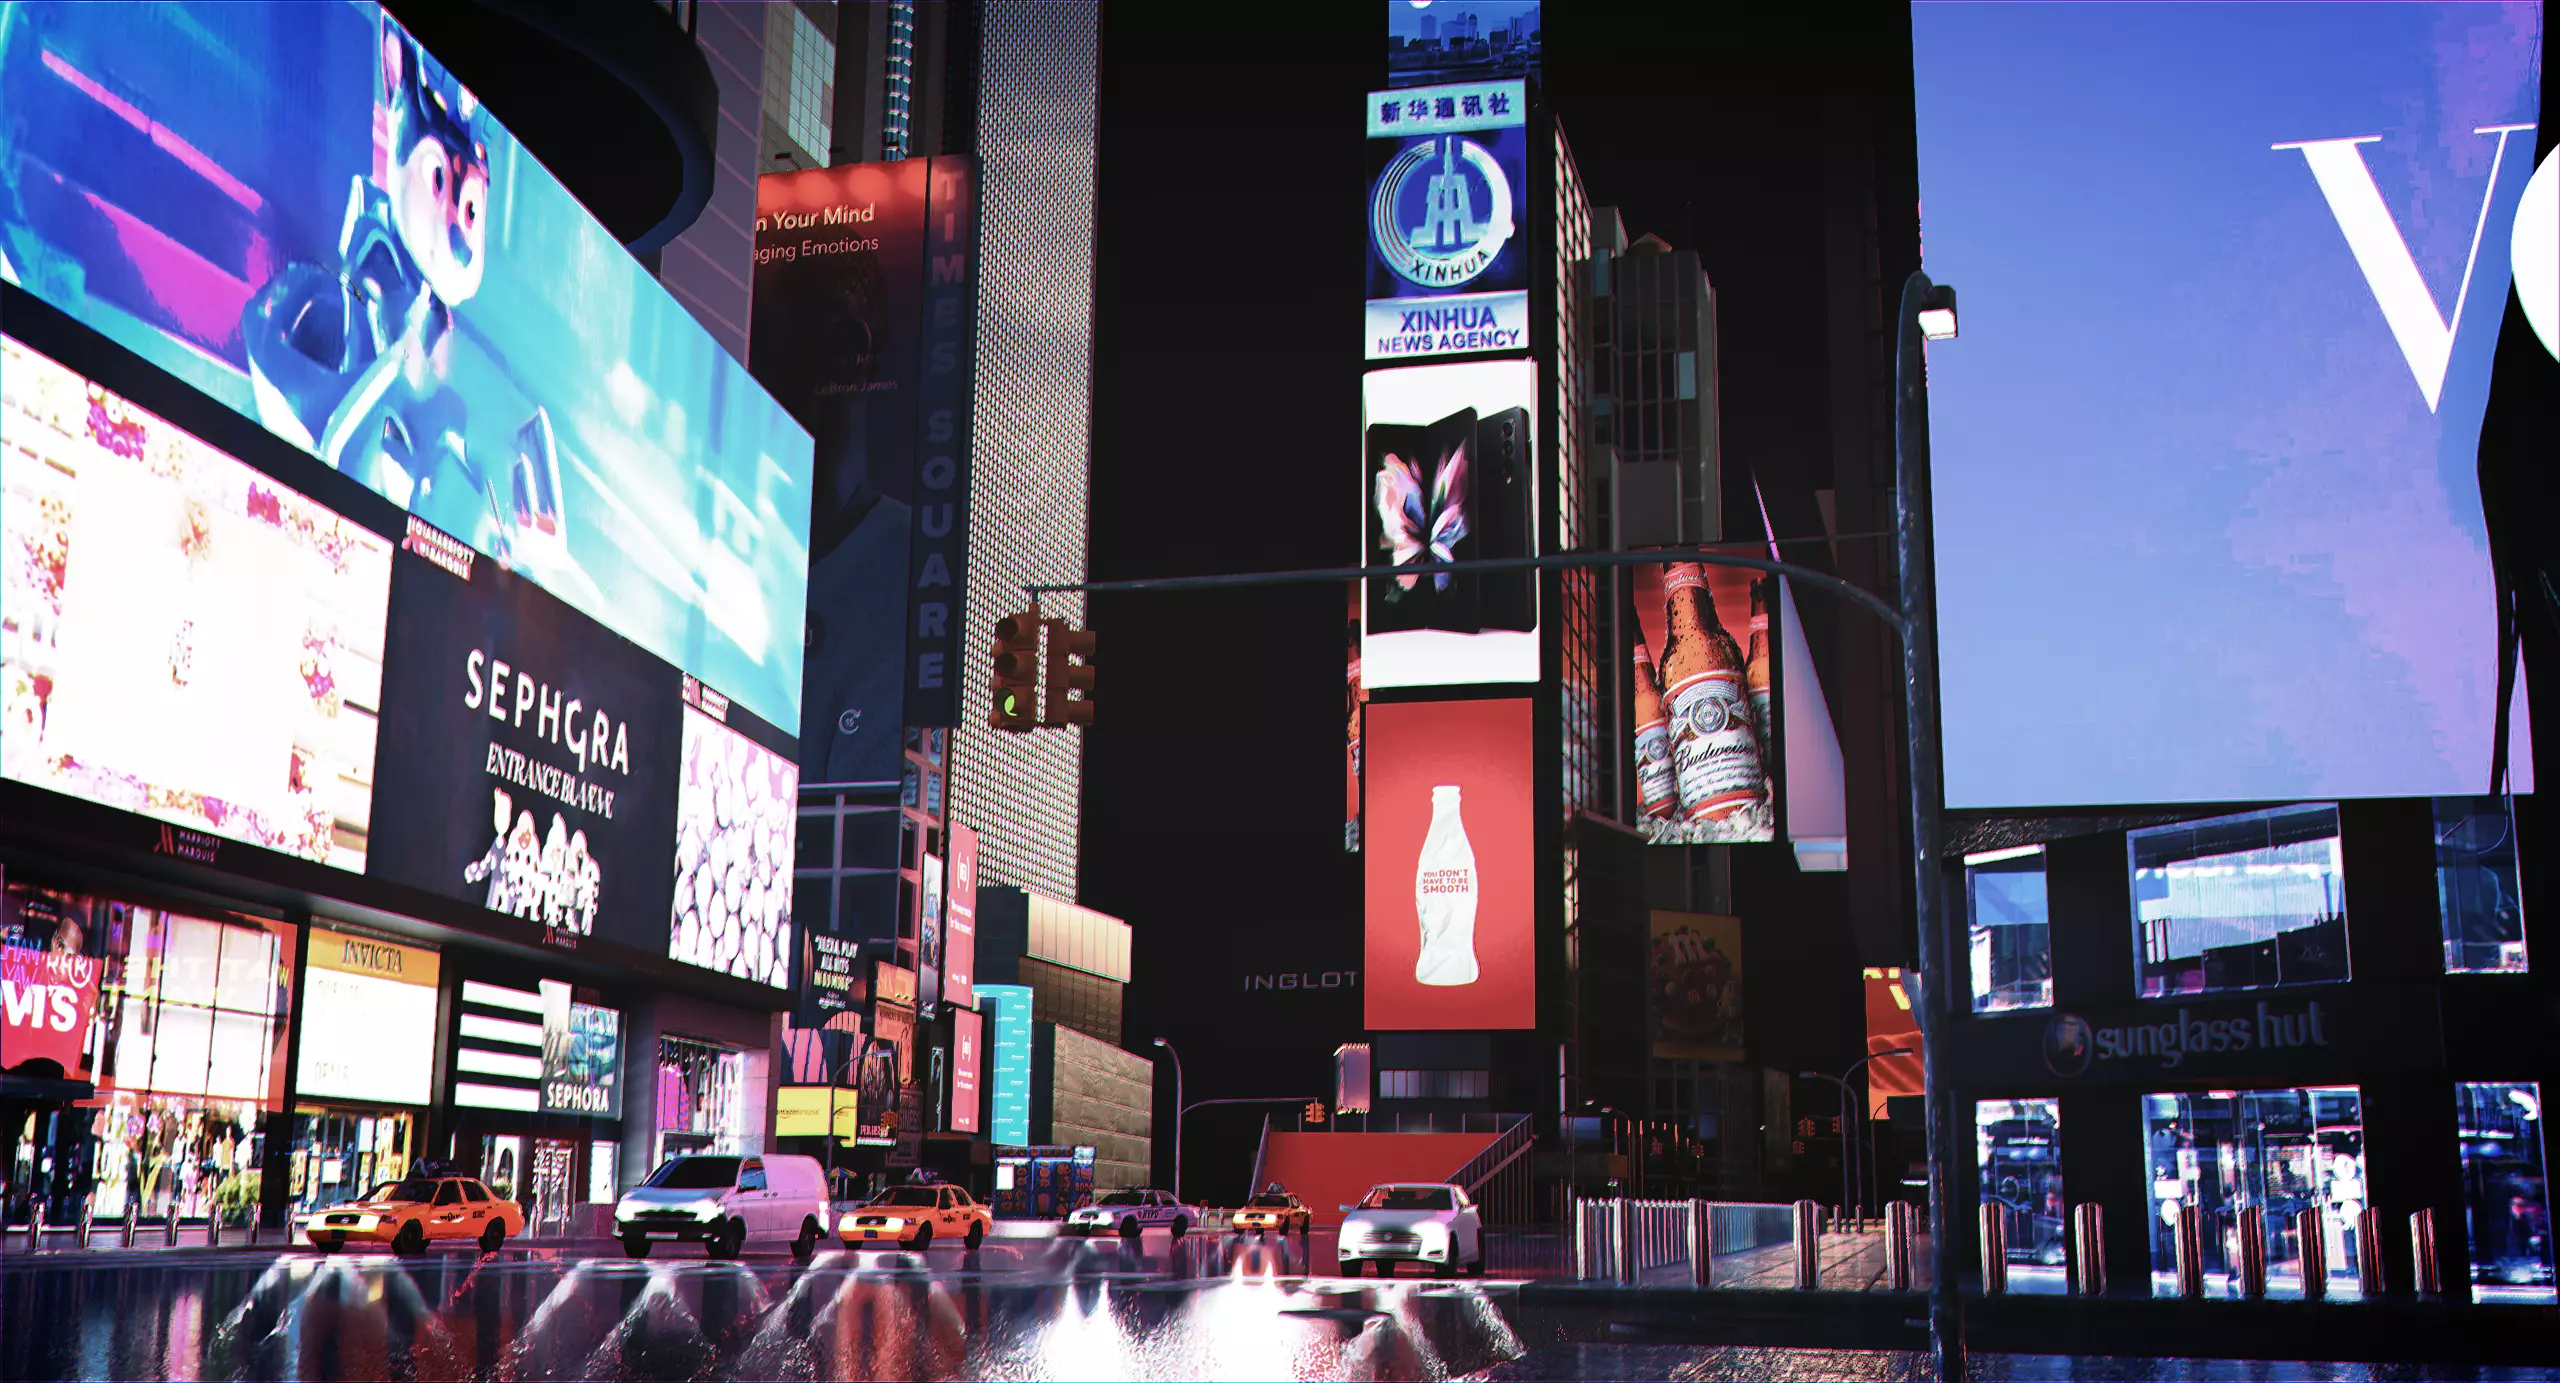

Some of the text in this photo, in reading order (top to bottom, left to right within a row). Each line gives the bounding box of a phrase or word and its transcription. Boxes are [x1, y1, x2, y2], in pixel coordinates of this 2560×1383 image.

[1380, 92, 1511, 124] 新华通讯社
[773, 208, 818, 231] Your
[823, 201, 876, 226] Mind
[802, 236, 879, 257] Emotions
[1409, 248, 1490, 284] XINHUA
[1400, 305, 1498, 334] XINHUA
[1378, 327, 1521, 354] NEWS AGENCY
[917, 171, 965, 690] TIMES SQUARE
[1439, 868, 1469, 877] DON'T
[1423, 885, 1469, 893] SMOOTH
[343, 940, 404, 973] INVICTA
[1244, 971, 1359, 991] INGLOT
[2096, 1001, 2329, 1069] sunglass hut
[547, 1080, 610, 1113] SEPHORA
